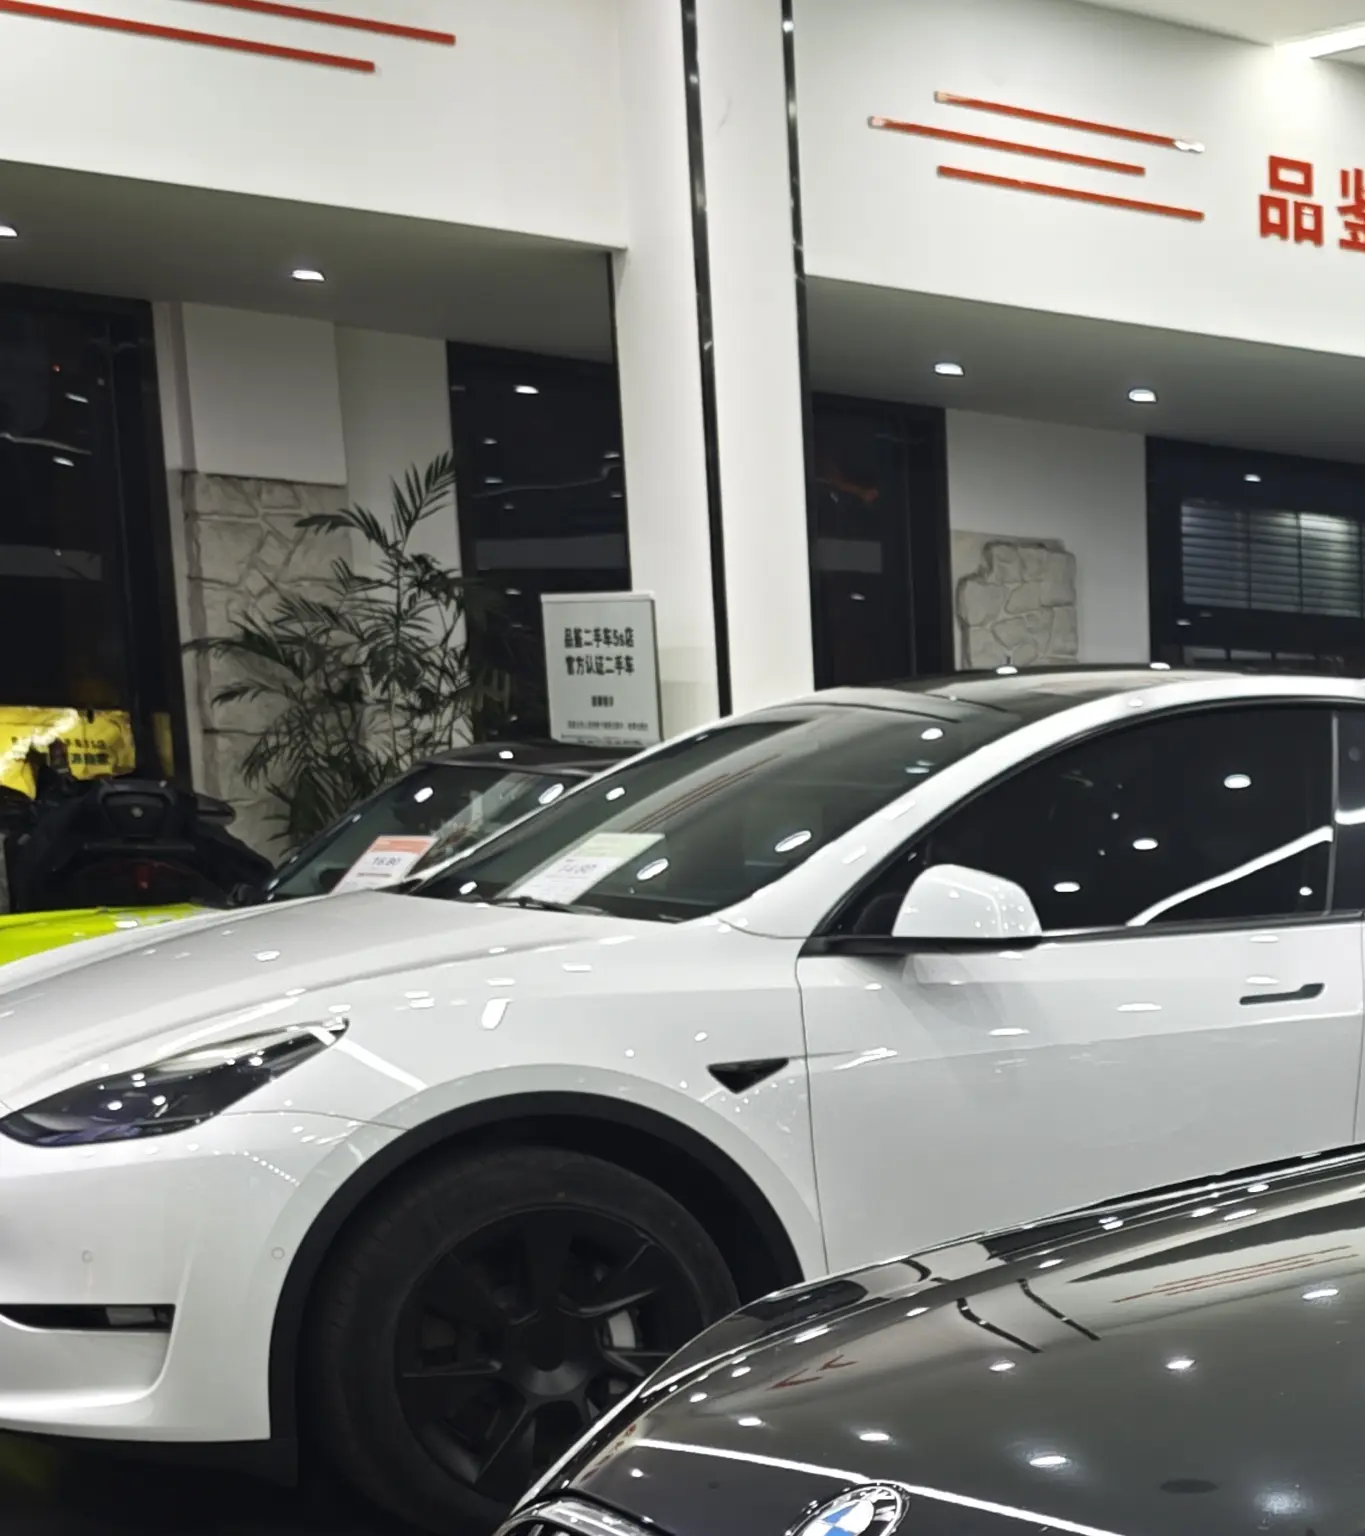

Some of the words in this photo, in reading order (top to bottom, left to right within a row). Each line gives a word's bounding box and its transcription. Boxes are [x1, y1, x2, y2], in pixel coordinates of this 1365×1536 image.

[565, 655, 635, 675] 官方认证二手车
